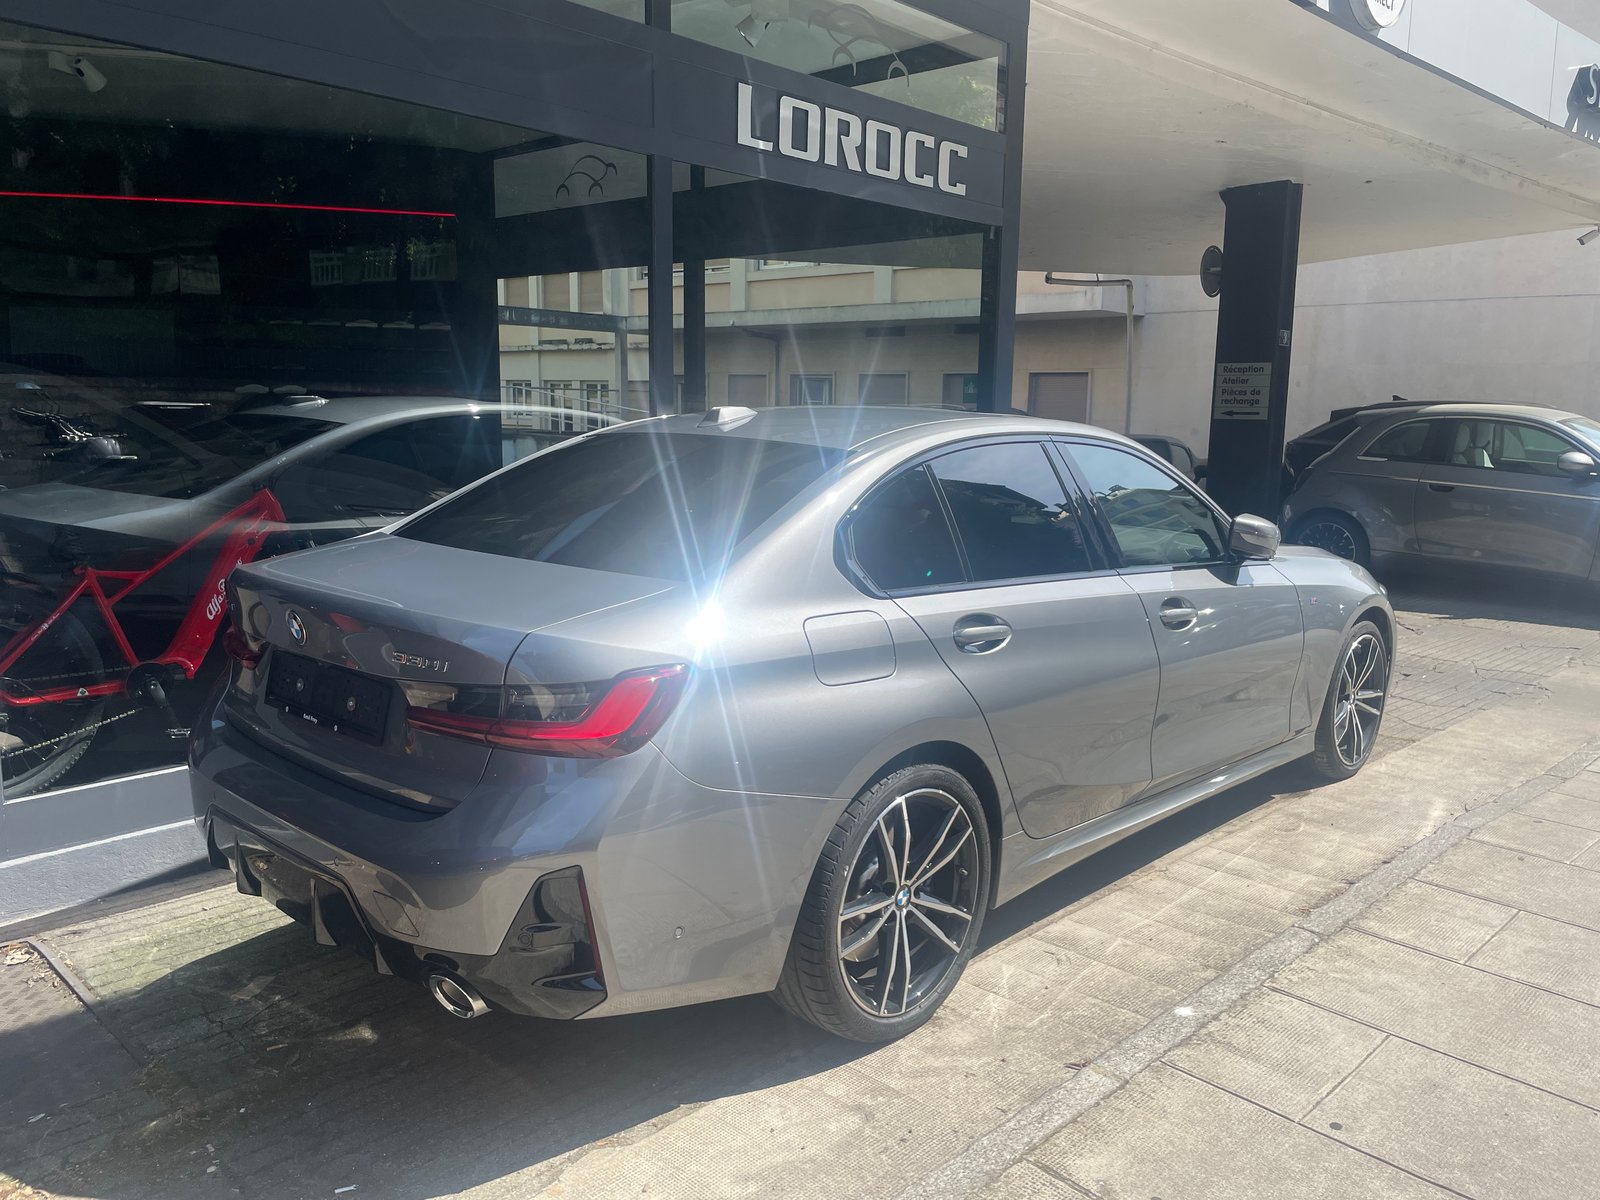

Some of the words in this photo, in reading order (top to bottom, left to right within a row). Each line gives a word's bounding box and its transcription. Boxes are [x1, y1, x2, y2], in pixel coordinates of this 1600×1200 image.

[737, 82, 968, 196] LOROCC
[1223, 365, 1264, 375] Réception
[1221, 377, 1249, 385] Atelier
[1221, 387, 1247, 396] Pièces
[1250, 388, 1261, 396] de
[1221, 397, 1260, 407] rechange
